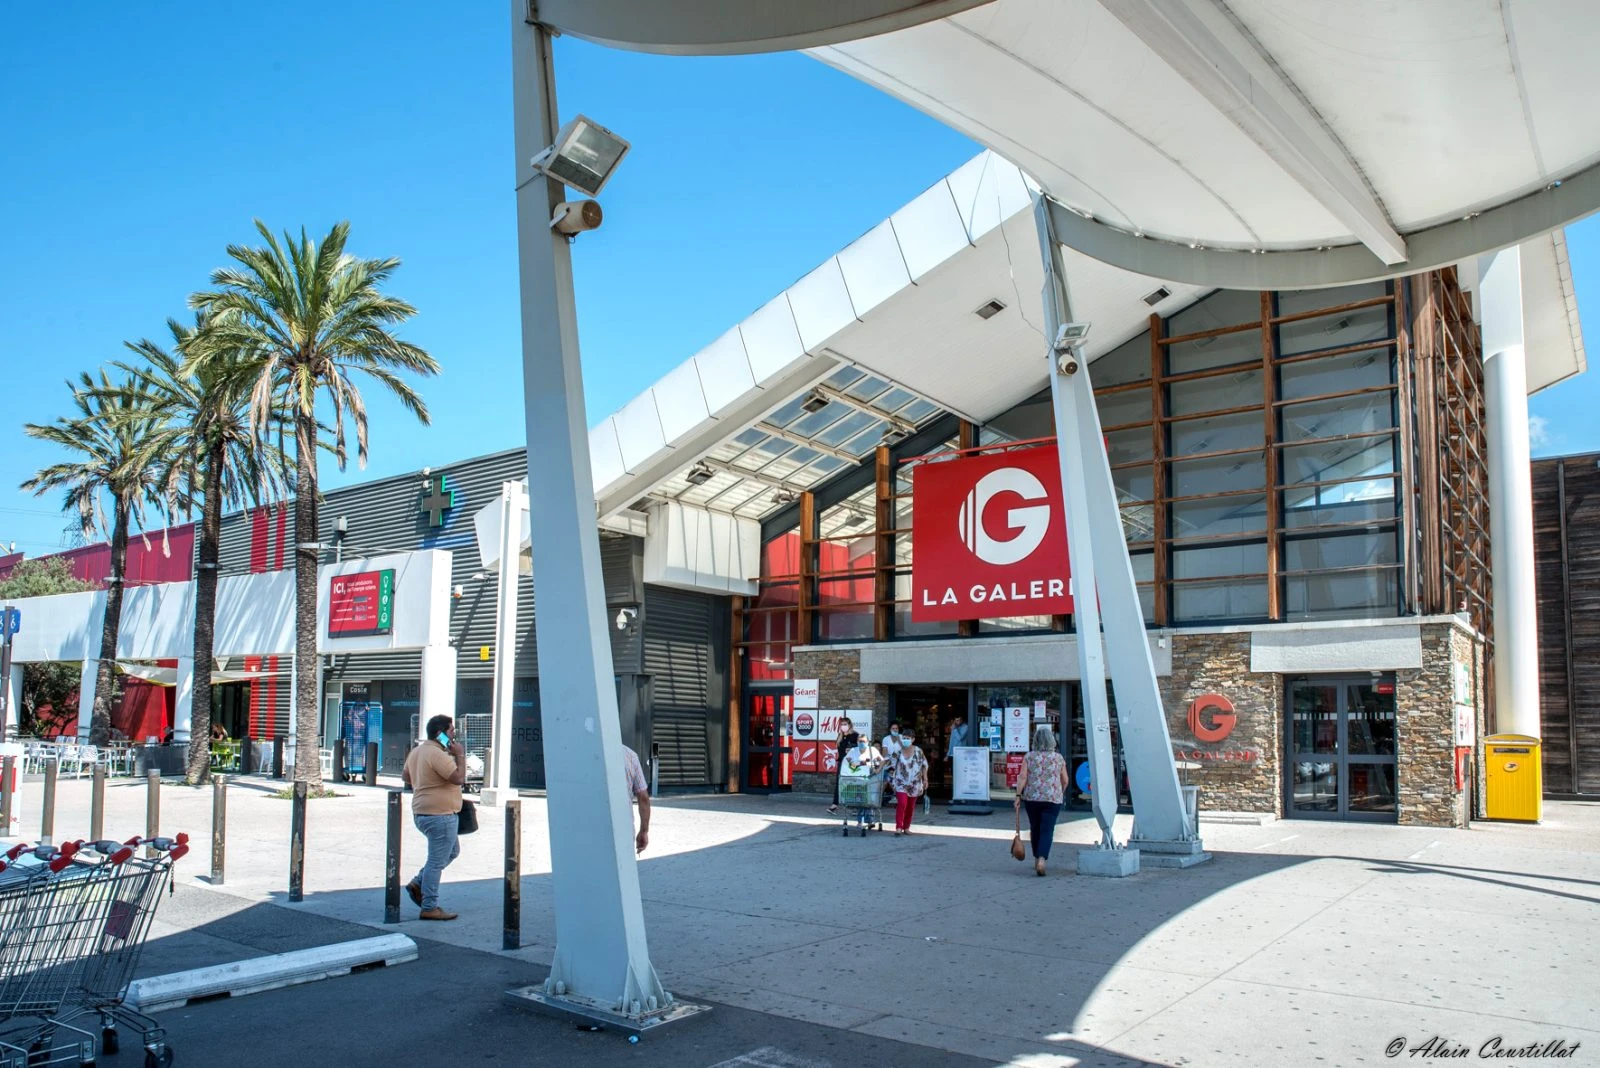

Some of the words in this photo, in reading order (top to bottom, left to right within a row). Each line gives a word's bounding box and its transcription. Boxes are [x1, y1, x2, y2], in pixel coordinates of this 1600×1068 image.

[334, 582, 346, 594] ICI,
[923, 587, 958, 606] LA
[969, 577, 1074, 603] GALERI
[795, 688, 816, 696] Géant
[820, 716, 844, 734] H&M
